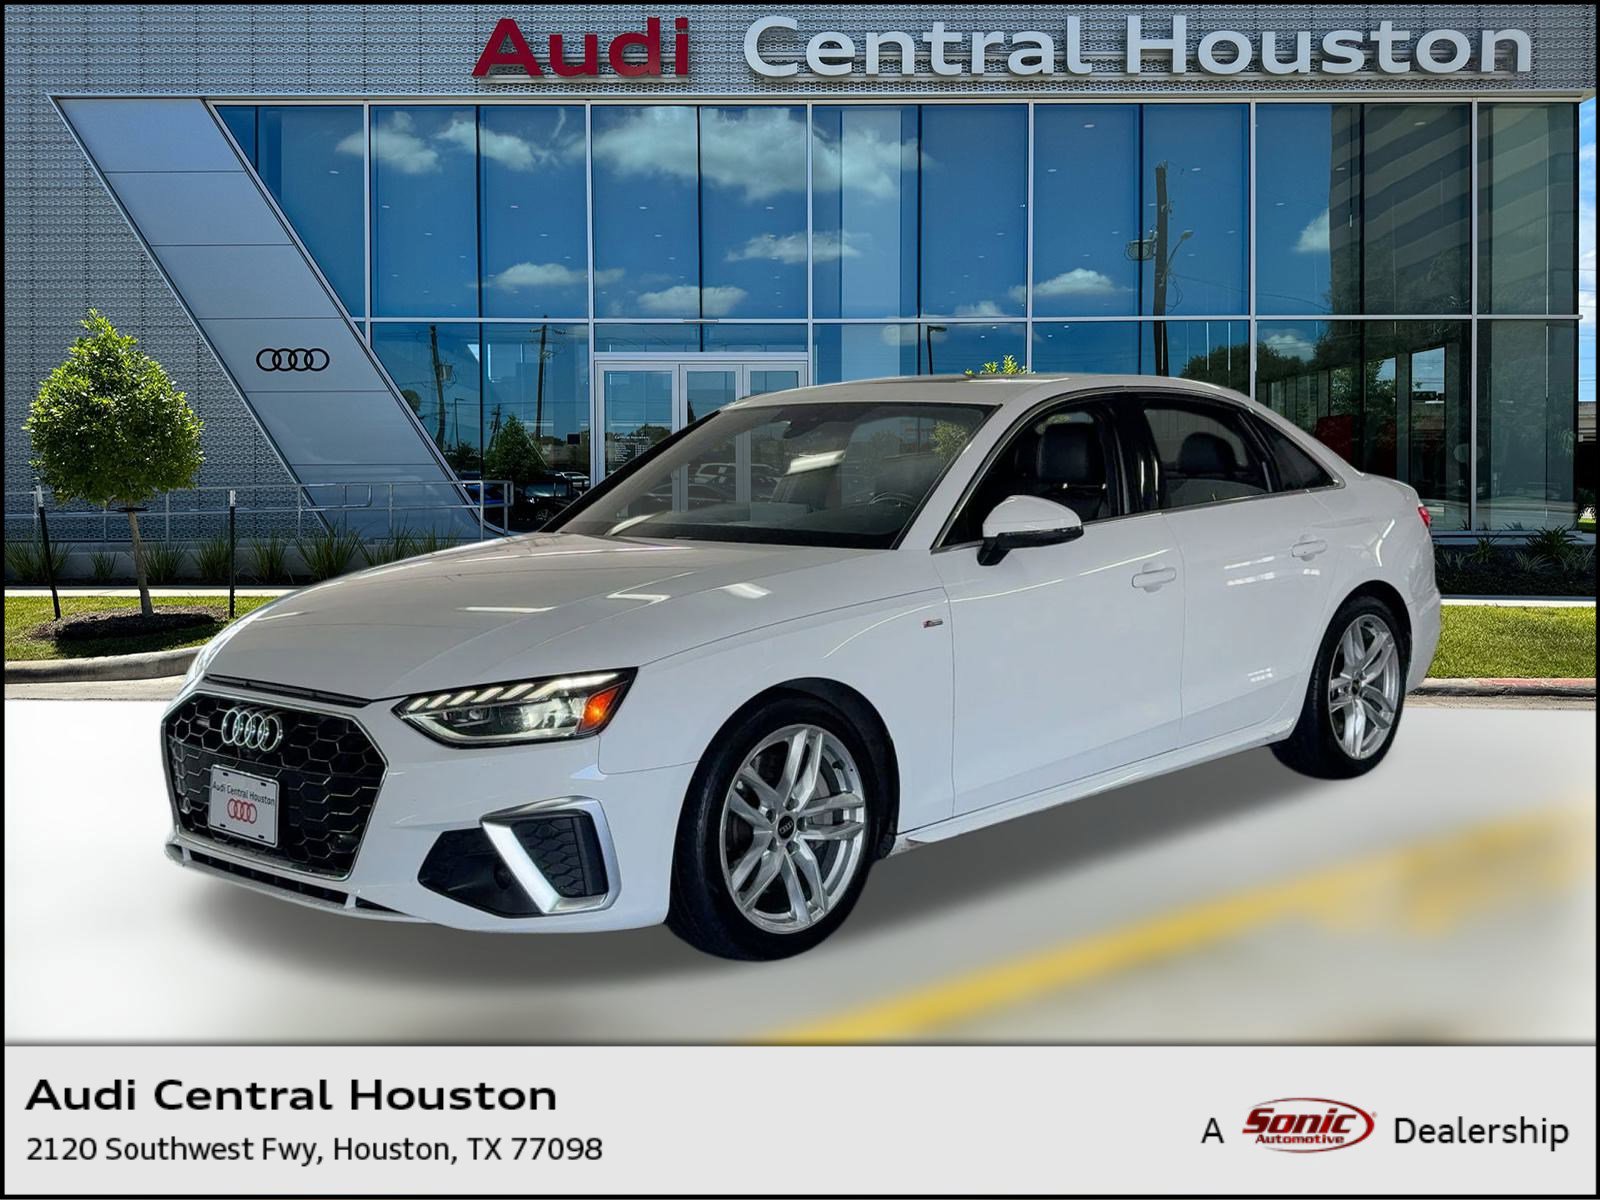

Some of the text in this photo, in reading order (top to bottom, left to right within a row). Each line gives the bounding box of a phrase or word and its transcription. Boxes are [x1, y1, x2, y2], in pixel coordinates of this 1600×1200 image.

[472, 15, 1532, 77] Audi Central Houston
[213, 781, 275, 806] Audi Central Houston
